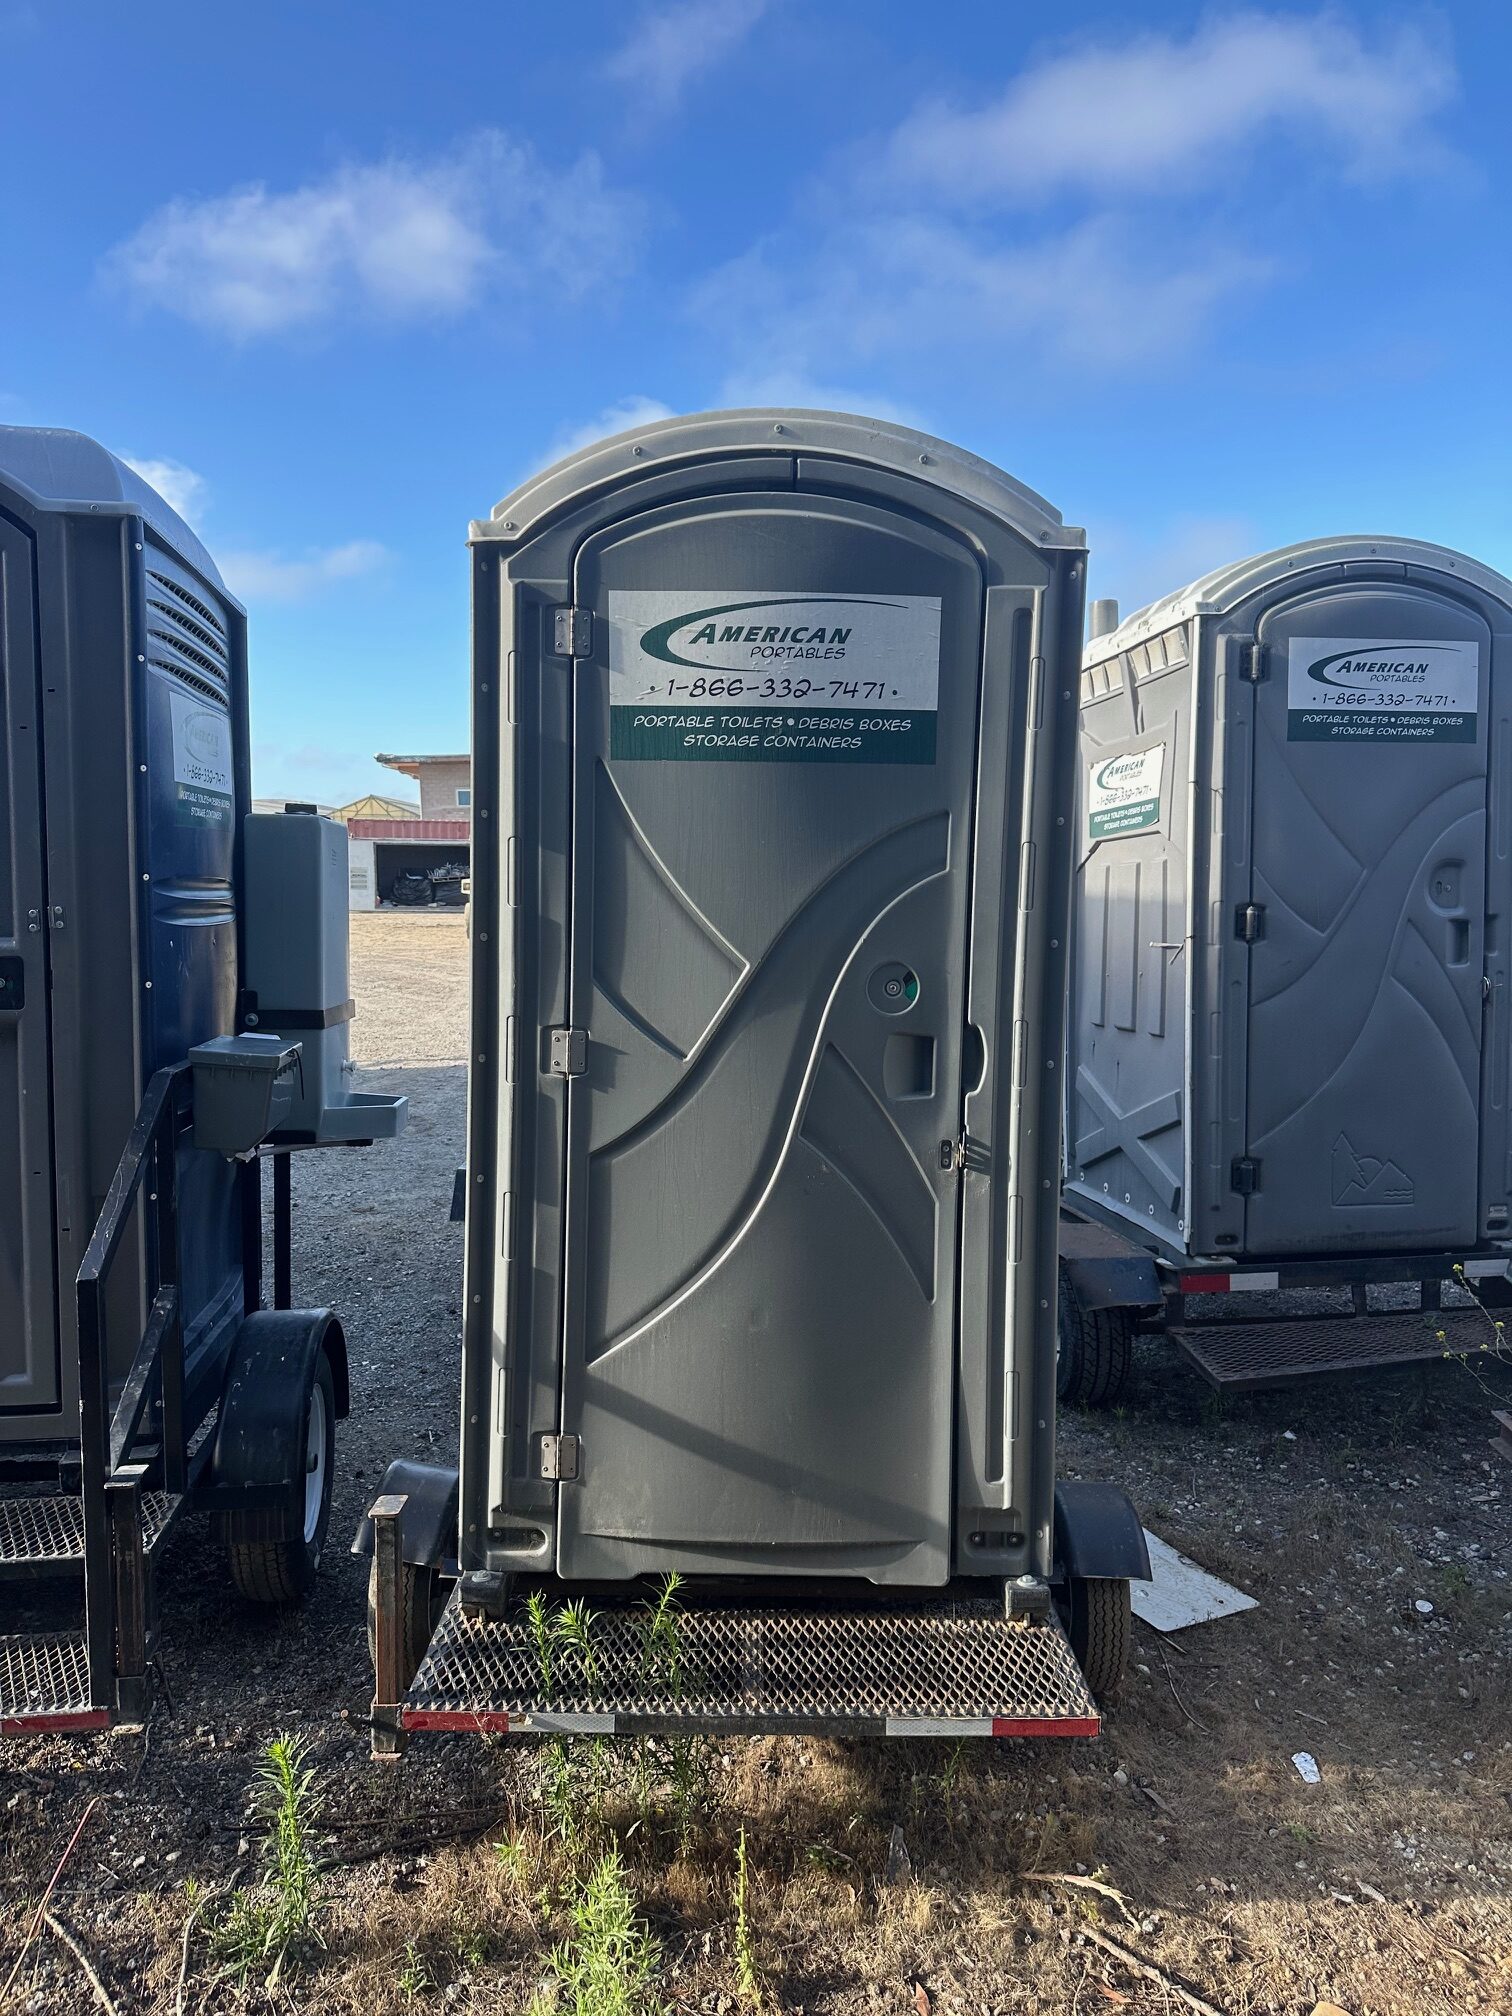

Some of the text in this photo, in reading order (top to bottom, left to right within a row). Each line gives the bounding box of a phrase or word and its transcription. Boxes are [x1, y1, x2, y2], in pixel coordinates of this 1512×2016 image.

[688, 624, 852, 645] AMERICAN
[750, 646, 846, 660] PORTABLES
[1336, 661, 1429, 673] AMERICAN
[1370, 675, 1425, 683] PORTABLES
[668, 678, 885, 699] 1-866-332-7471
[1323, 693, 1447, 706] 1-866-332-7471
[634, 716, 911, 731] PORTABLE TOILETS DEBRIS BOXES
[1303, 715, 1349, 723] PORTABLE
[1397, 716, 1430, 725] DEBRIS
[1433, 717, 1463, 725] BOXES
[1332, 727, 1434, 736] STORAGE CONTAINERS
[683, 735, 862, 748] STORAGE CONTAINERS
[1107, 759, 1145, 778] AMERICAN
